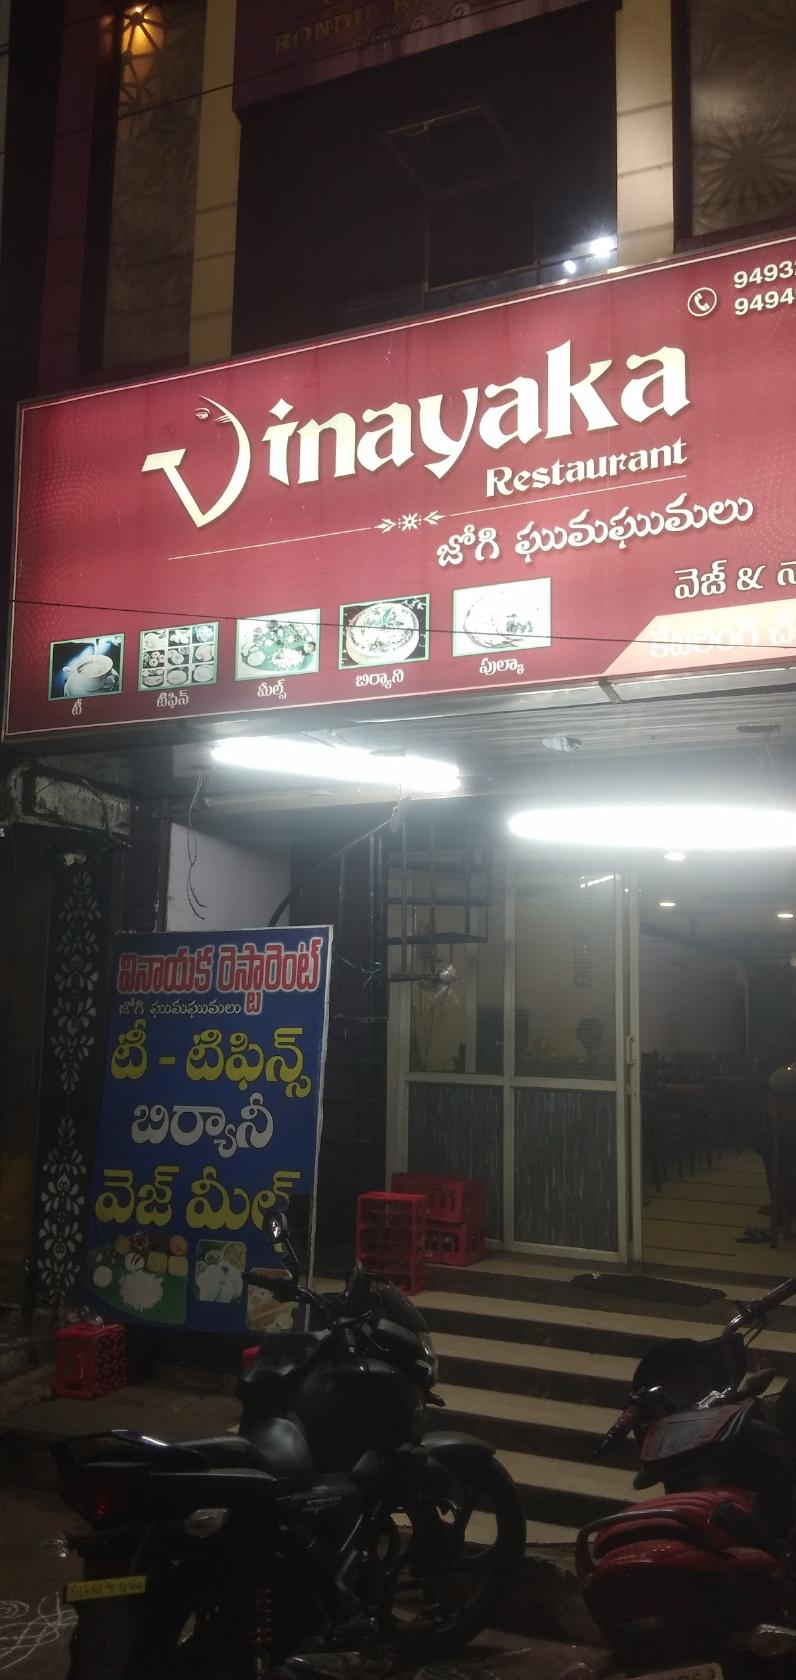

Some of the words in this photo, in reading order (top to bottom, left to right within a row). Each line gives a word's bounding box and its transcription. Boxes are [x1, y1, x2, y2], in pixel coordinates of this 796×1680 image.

[734, 260, 796, 289] 9493
[734, 287, 796, 316] 9494
[142, 340, 690, 527] Vinayaka
[486, 438, 688, 498] Restaurant
[436, 523, 500, 567] జోగి
[514, 492, 754, 563] ఘుమఘుమలు
[674, 559, 728, 599] వెజ్
[737, 565, 766, 591] &
[257, 679, 287, 700] మీల్స్
[479, 657, 526, 676] పుల్కా
[72, 698, 82, 716] టీ
[156, 689, 190, 709] టిఫిన్
[117, 946, 214, 993] వినాయక
[217, 937, 323, 1015] రెస్టారెంట్
[110, 1018, 147, 1080] టీ
[159, 1056, 176, 1065] -
[185, 1027, 312, 1098] టిఫిన్స్
[131, 1092, 274, 1158] బిర్యానీ
[95, 1165, 180, 1227] వెజ్
